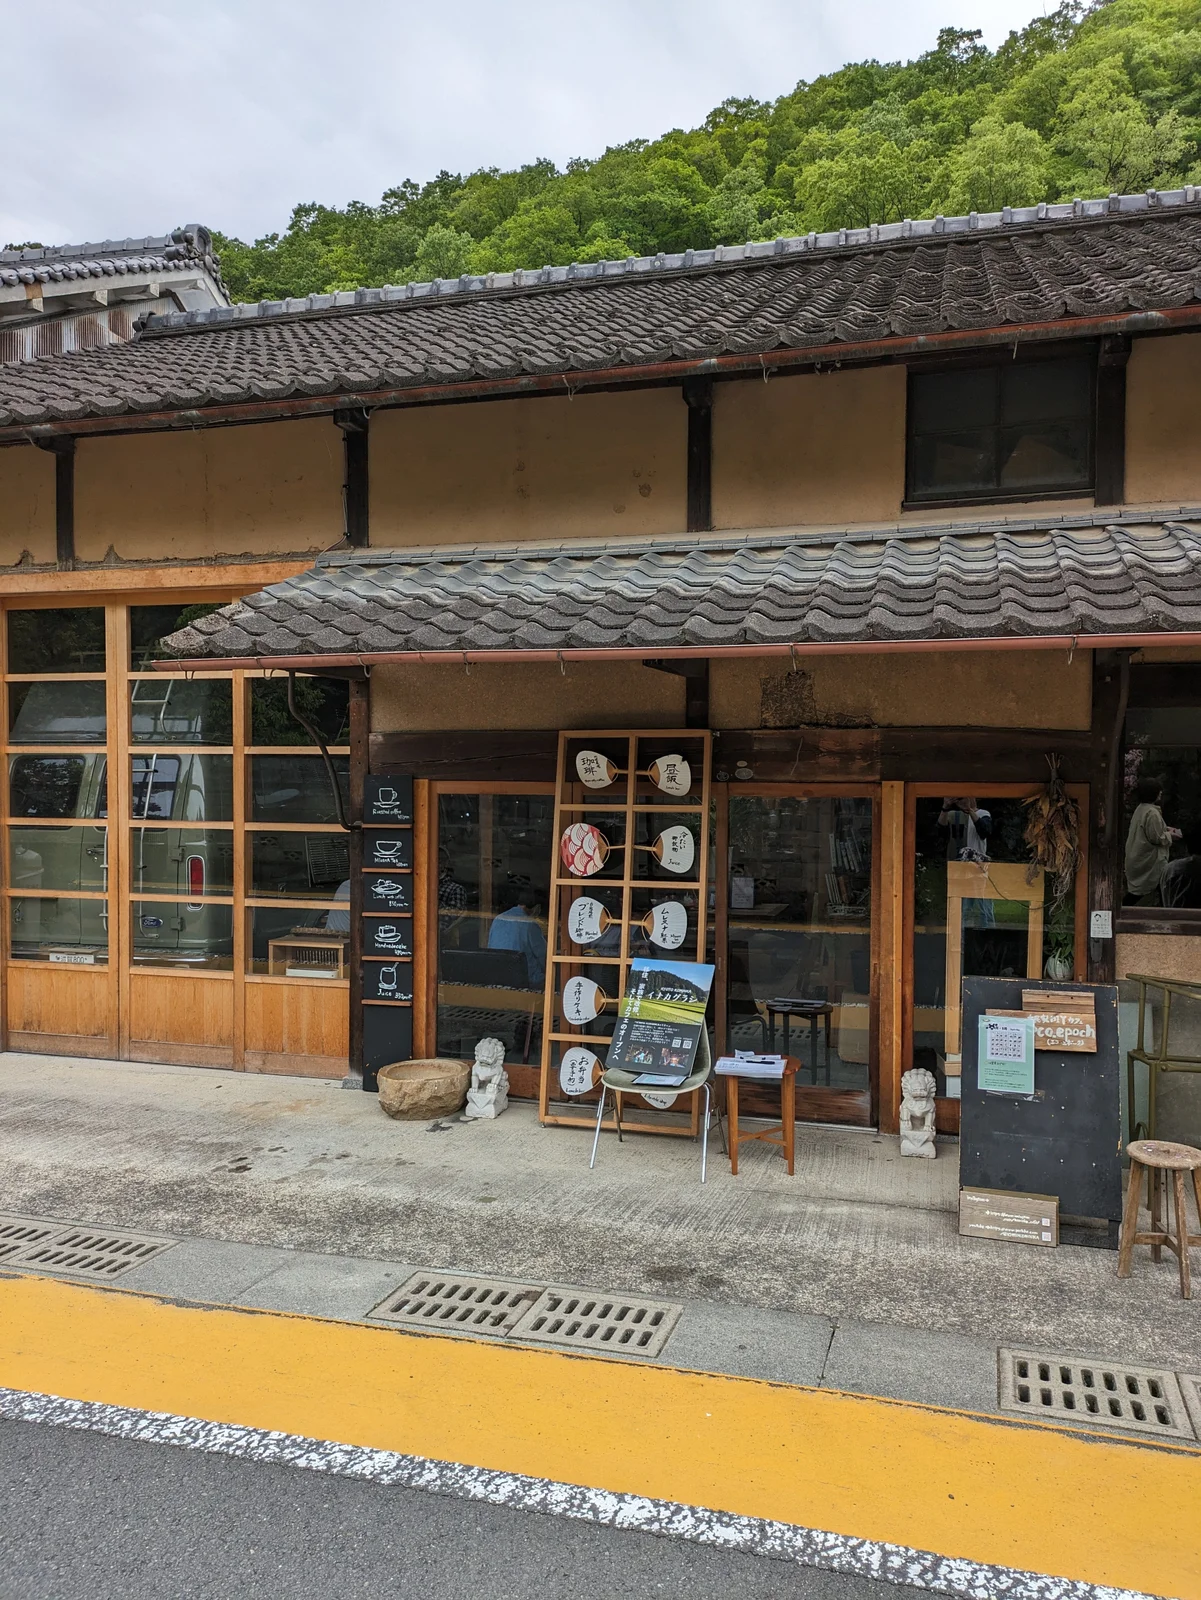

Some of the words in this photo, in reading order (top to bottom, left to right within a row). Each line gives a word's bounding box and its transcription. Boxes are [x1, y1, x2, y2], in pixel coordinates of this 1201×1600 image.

[581, 756, 598, 776] 珈琲
[663, 763, 684, 786] 昼飯
[679, 831, 688, 850] 冷たい
[667, 858, 681, 866] Juice
[377, 988, 392, 997] Juice
[647, 991, 698, 1004] イナカグラシ
[578, 1056, 589, 1084] お弁当
